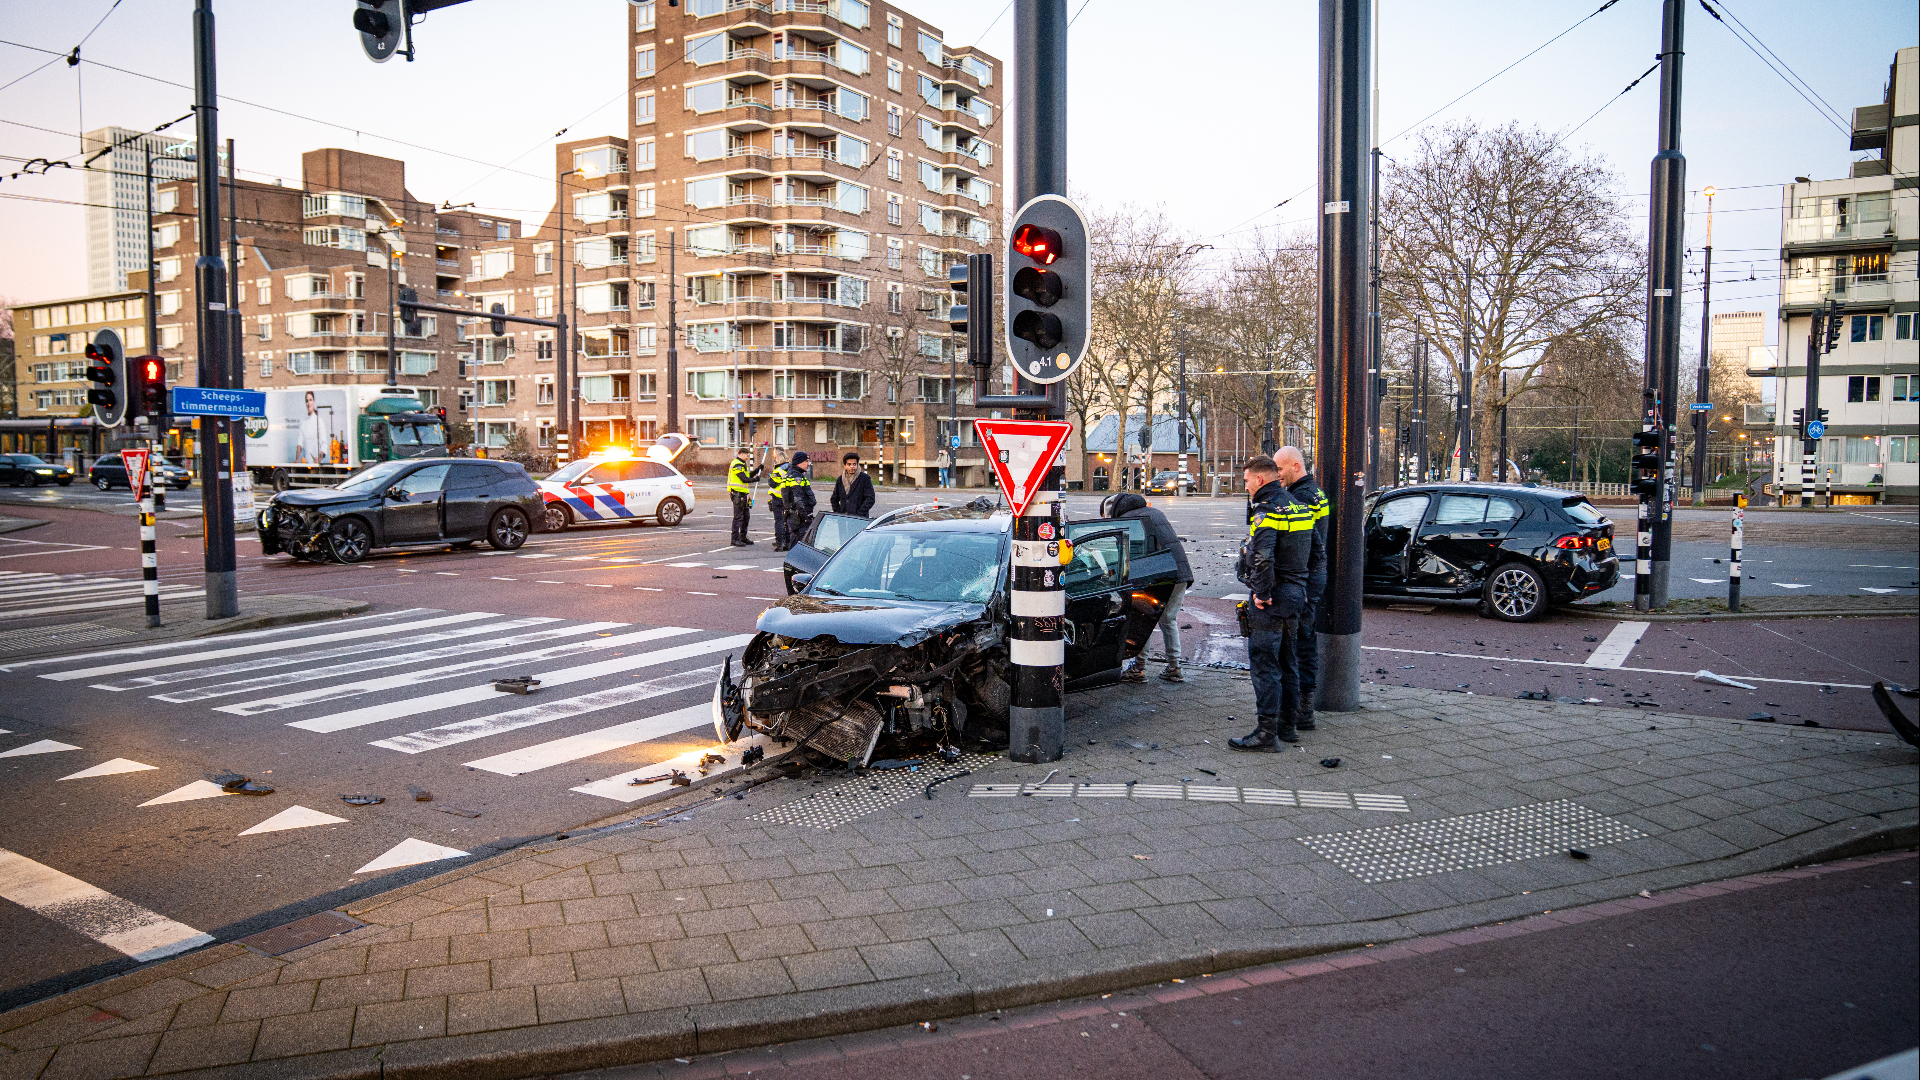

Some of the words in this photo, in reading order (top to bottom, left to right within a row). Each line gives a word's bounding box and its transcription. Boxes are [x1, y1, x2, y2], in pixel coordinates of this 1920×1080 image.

[1040, 356, 1051, 366] 4.1
[201, 390, 244, 403] Scheeps-
[181, 401, 260, 414] timmermanslaan
